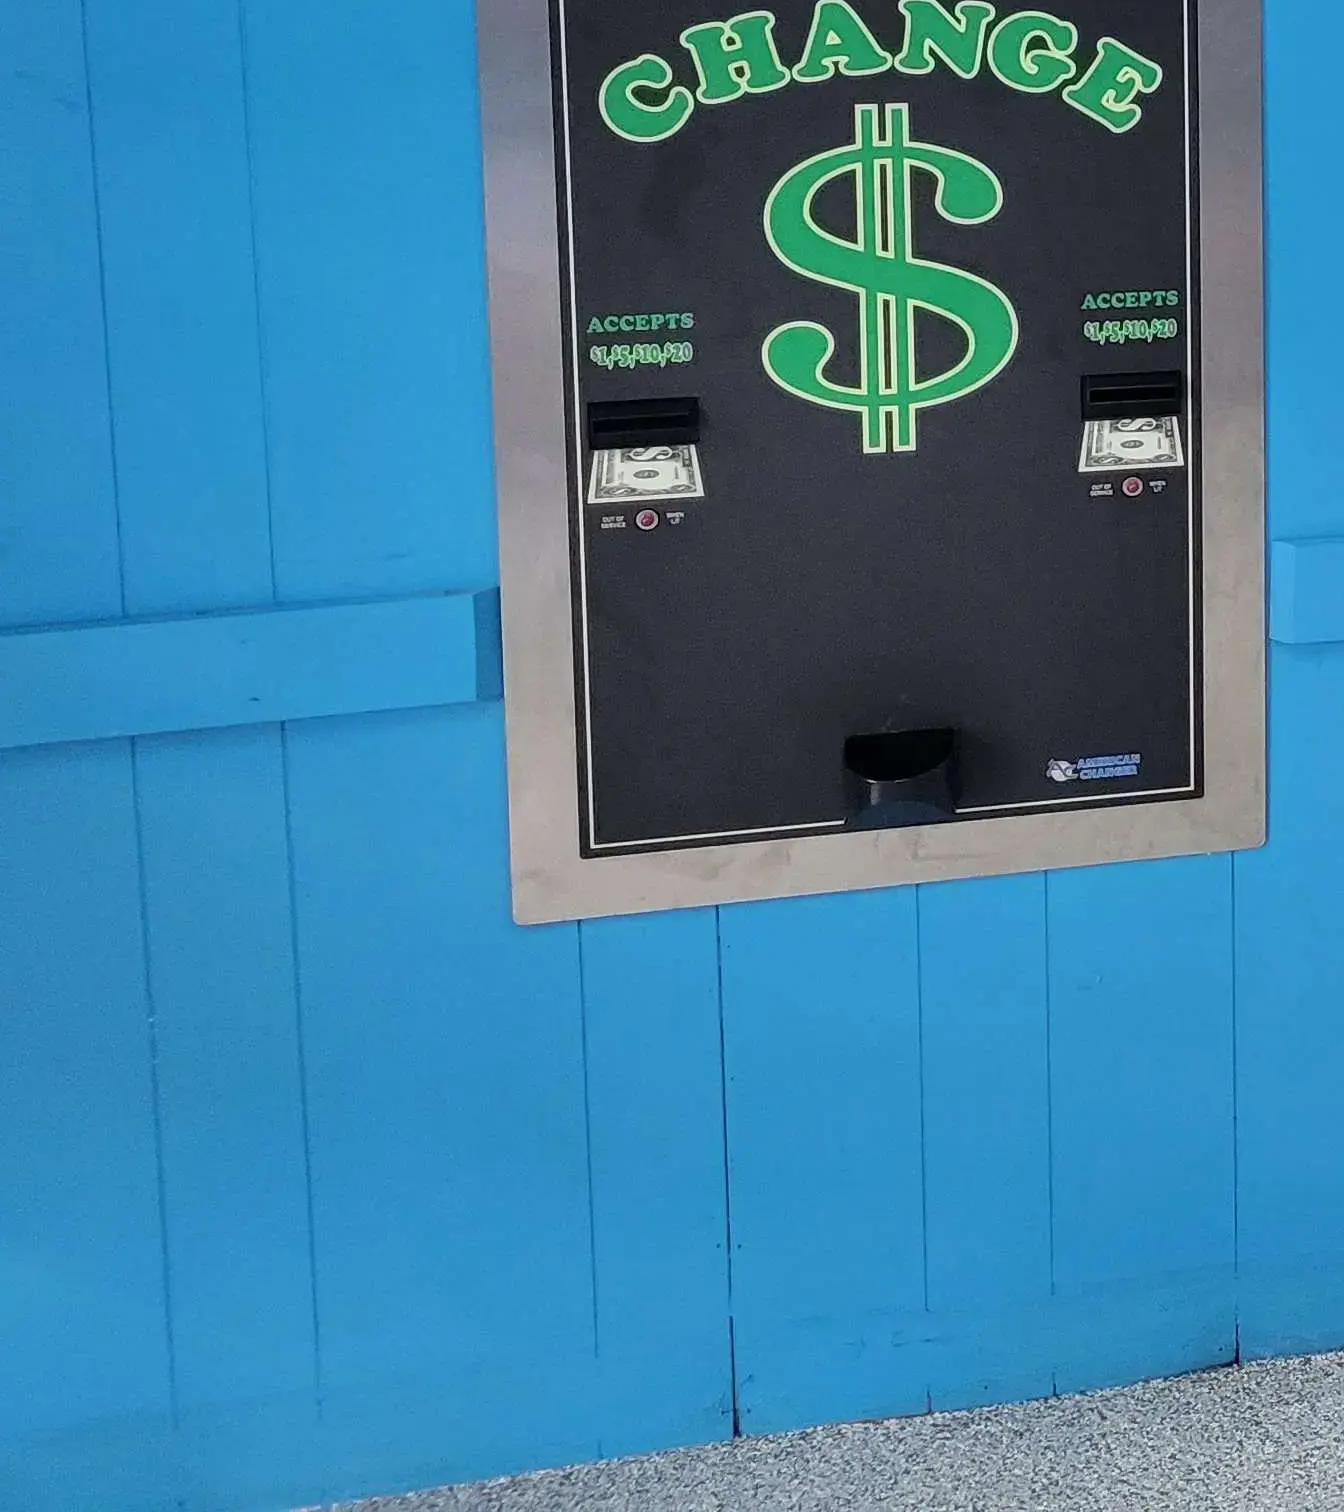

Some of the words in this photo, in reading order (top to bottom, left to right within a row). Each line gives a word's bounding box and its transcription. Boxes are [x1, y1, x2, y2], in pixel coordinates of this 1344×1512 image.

[1080, 290, 1180, 310] ACCEPTS
[586, 312, 695, 334] ACCEPTS
[589, 341, 694, 371] $1,$5,$10,$20
